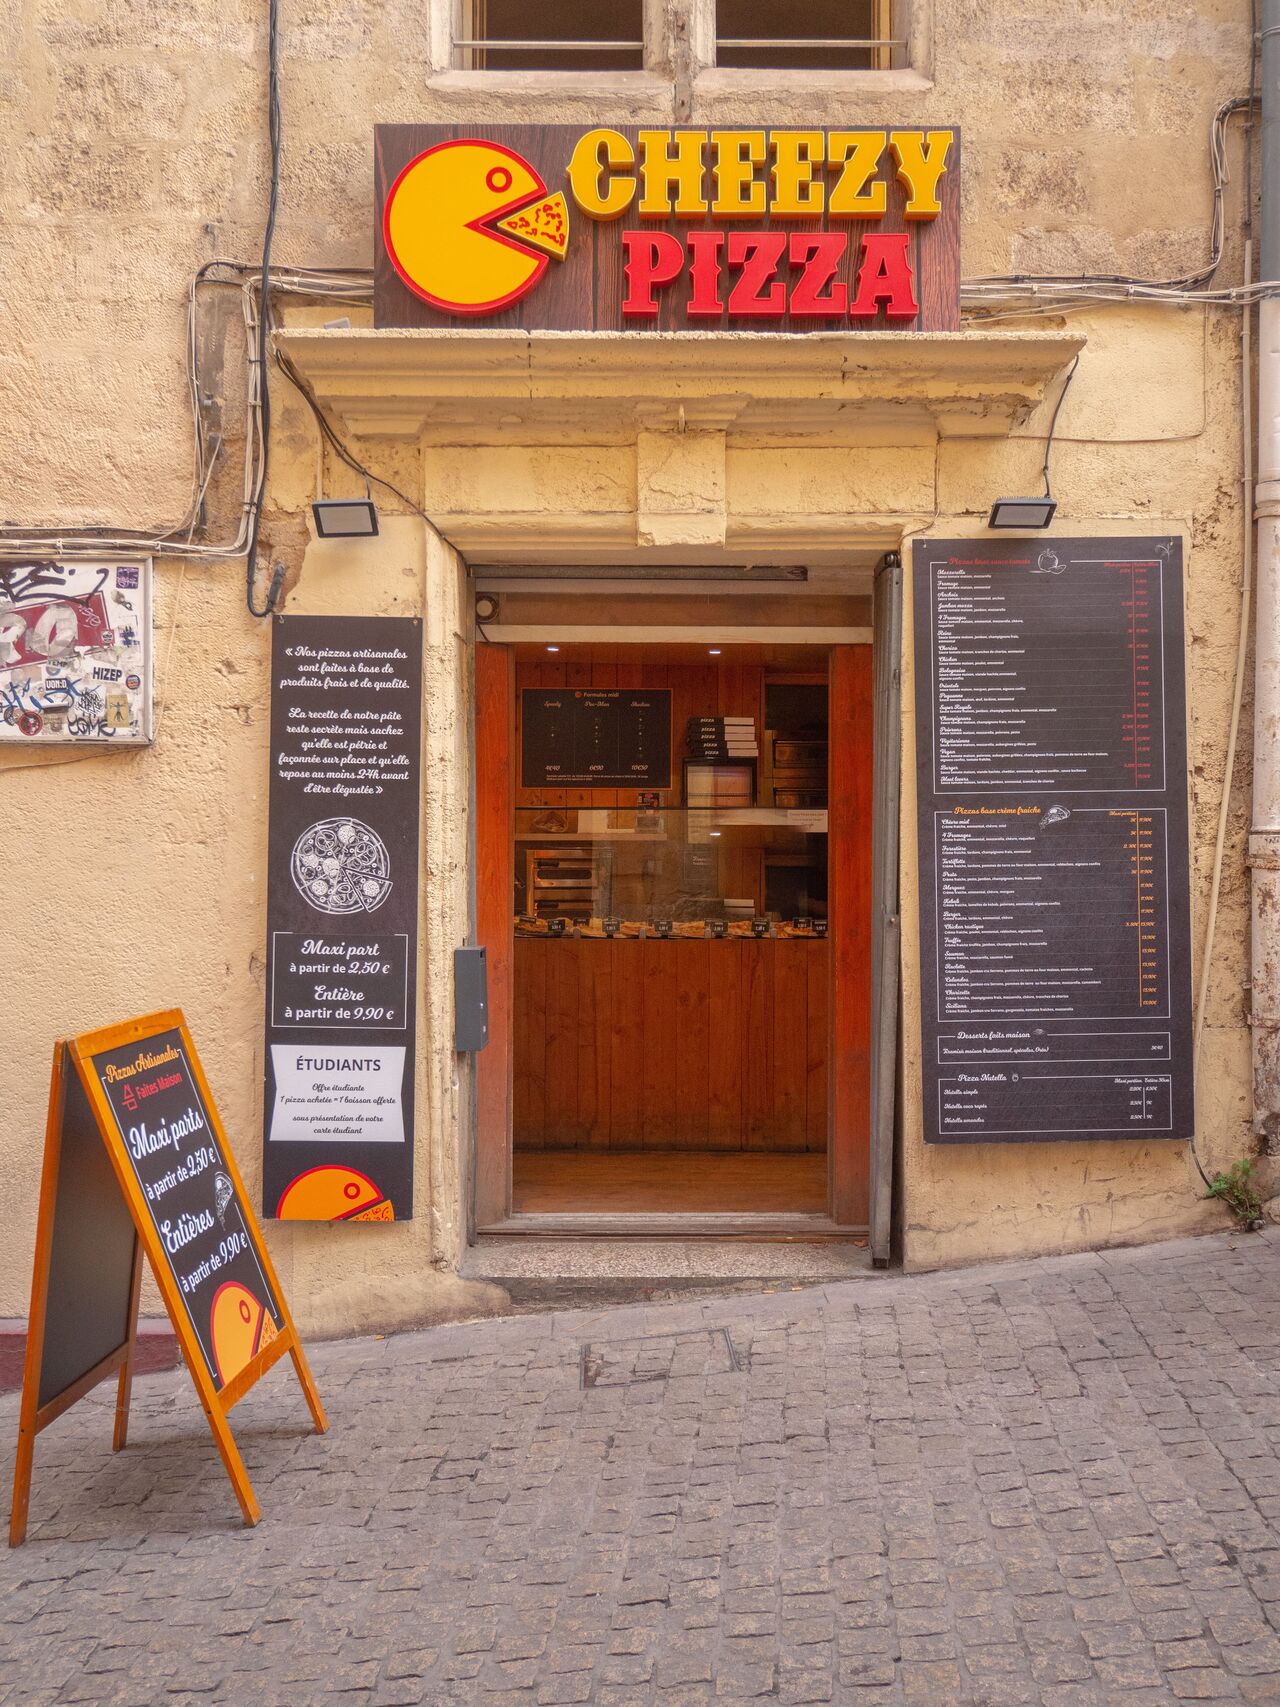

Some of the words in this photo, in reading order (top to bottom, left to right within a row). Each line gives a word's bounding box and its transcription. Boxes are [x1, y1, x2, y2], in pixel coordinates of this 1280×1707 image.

[567, 129, 954, 221] CHEEZY
[622, 232, 919, 320] PIZZA
[295, 646, 316, 657] Nos
[317, 648, 351, 659] pizzas
[352, 649, 407, 659] artisanales
[93, 667, 122, 681] HIZEP
[298, 664, 320, 672] sont
[320, 662, 348, 674] faites
[349, 662, 356, 672] à
[356, 663, 380, 673] base
[382, 663, 394, 673] de
[280, 677, 323, 689] produits
[324, 677, 348, 689] frais
[350, 679, 358, 688] et
[360, 678, 372, 688] de
[374, 679, 410, 691] qualité.
[288, 708, 307, 718] La
[308, 710, 339, 719] recette
[340, 709, 352, 720] de
[354, 711, 379, 720] notre
[380, 711, 402, 722] pâte
[286, 725, 309, 733] reste
[311, 724, 343, 734] secrète
[345, 725, 369, 734] mais
[370, 725, 403, 735] sachez
[334, 740, 348, 748] est
[348, 740, 376, 751] pétrie
[378, 741, 387, 749] et
[278, 753, 321, 765] façonnée
[323, 756, 339, 764] sur
[340, 754, 366, 766] place
[368, 756, 377, 764] et
[279, 771, 310, 780] repose
[326, 770, 356, 779] moins
[357, 769, 380, 779] 24h
[381, 771, 409, 780] avant
[333, 784, 374, 797] dégustée
[954, 807, 979, 815] Pizzas
[301, 940, 345, 955] Maxi
[346, 943, 379, 959] part
[290, 963, 297, 973] à
[299, 964, 330, 974] partir
[332, 964, 345, 973] de
[314, 985, 365, 1000] Entière
[285, 1007, 292, 1018] à
[296, 1008, 332, 1020] partir
[335, 1008, 350, 1018] de
[957, 1031, 988, 1039] Desserts
[989, 1031, 1005, 1040] faits
[106, 1064, 137, 1083] Pizzas
[135, 1044, 179, 1072] Artisanales
[296, 1056, 380, 1071] ÉTUDIANTS
[135, 1081, 158, 1099] Faites
[157, 1072, 182, 1091] Maison
[312, 1083, 330, 1092] Offre
[332, 1084, 364, 1092] étudiante
[285, 1097, 305, 1105] pizza
[307, 1096, 332, 1104] achetée
[344, 1096, 371, 1104] boisson
[373, 1097, 395, 1105] offerte
[310, 1114, 354, 1123] présentation
[130, 1118, 171, 1160] Maxi
[171, 1107, 204, 1150] parts
[147, 1184, 154, 1199] à
[154, 1170, 176, 1200] partir
[177, 1165, 188, 1182] de
[161, 1209, 214, 1254] Entières
[183, 1277, 190, 1292] à
[189, 1263, 210, 1294] partir
[210, 1254, 222, 1271] de
